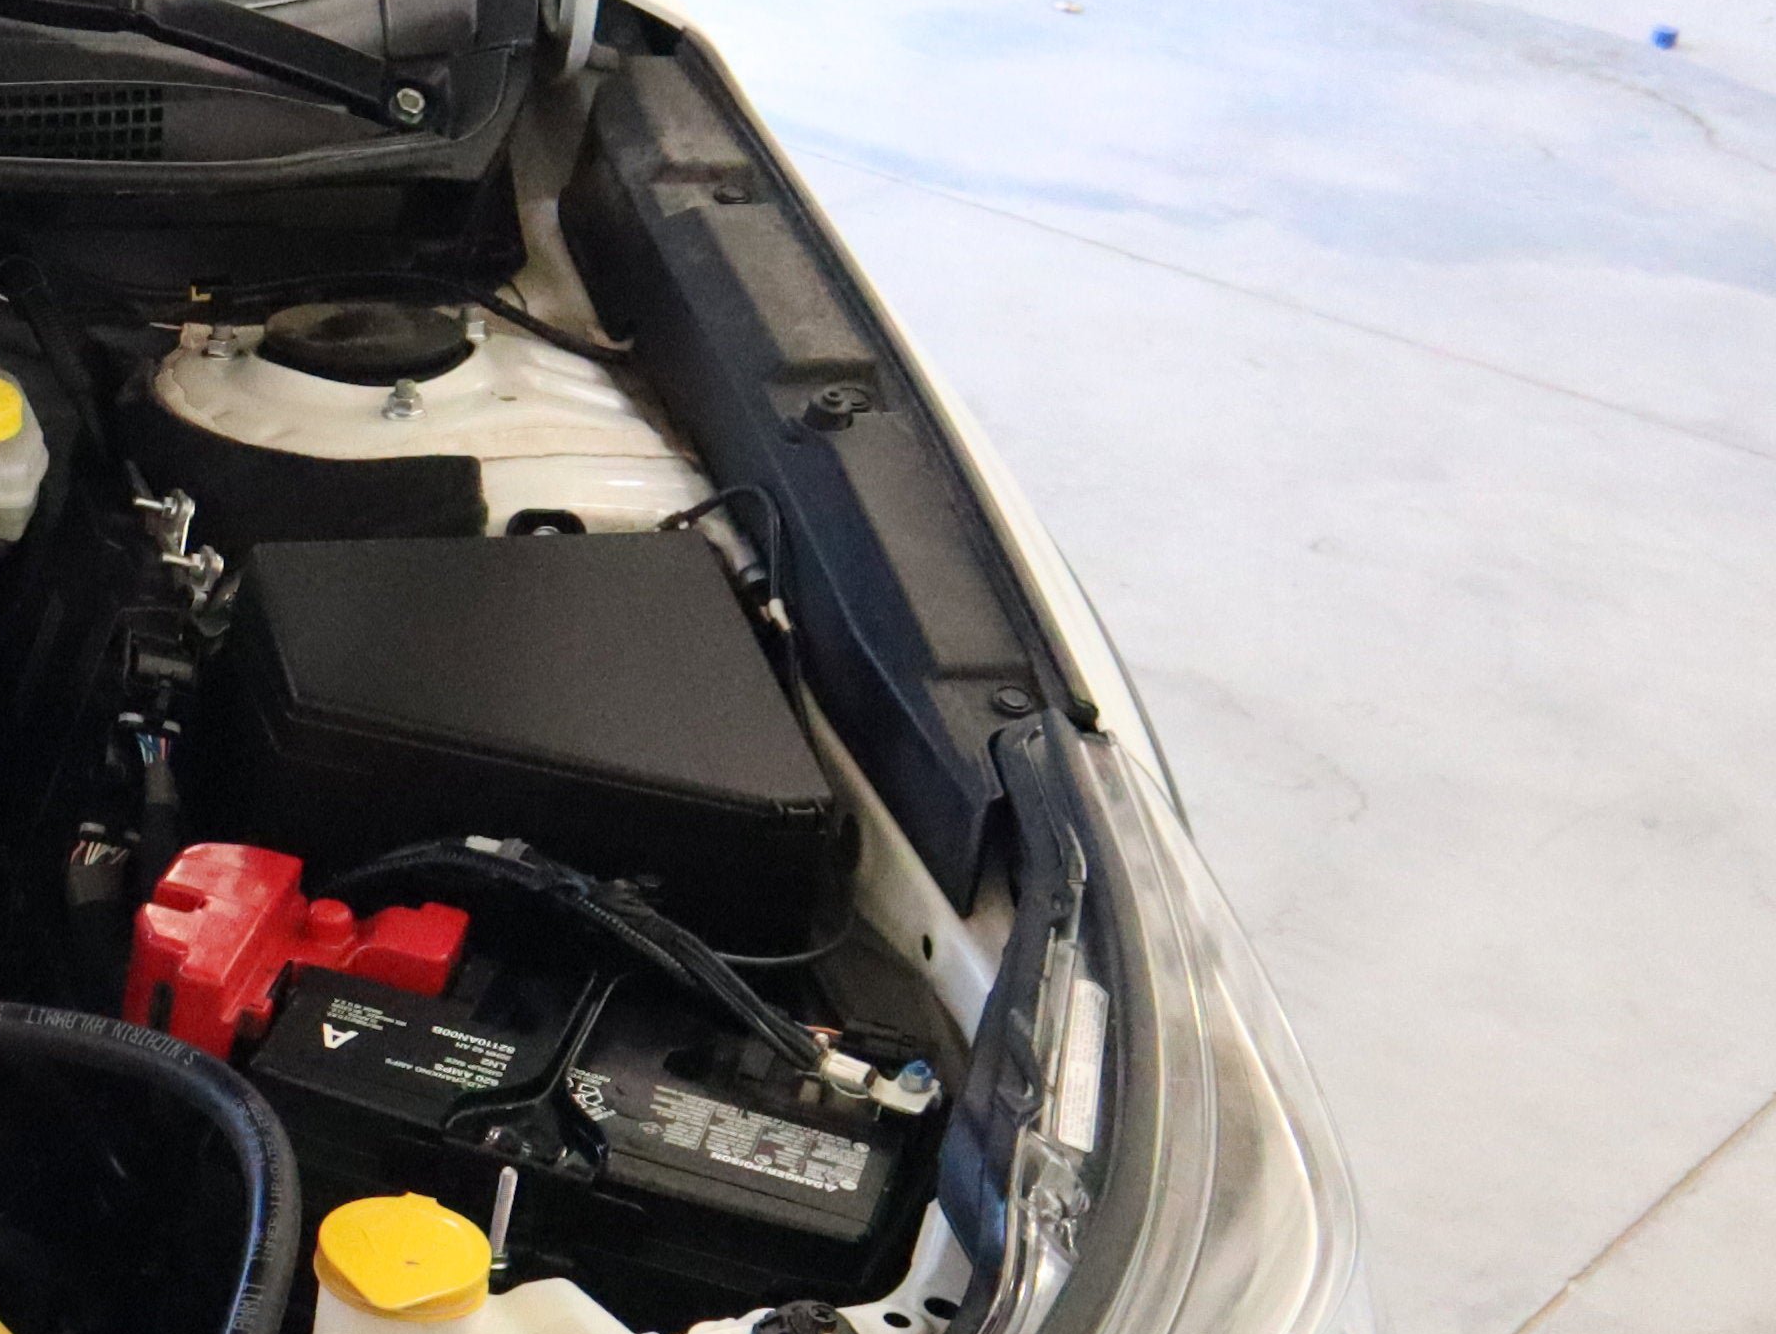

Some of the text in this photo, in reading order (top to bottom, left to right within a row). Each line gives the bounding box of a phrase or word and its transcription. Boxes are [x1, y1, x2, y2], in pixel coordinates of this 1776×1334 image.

[110, 1021, 185, 1059] NICHIRIN
[433, 1062, 475, 1080] AMPS
[479, 1057, 507, 1072] LN2
[710, 1151, 824, 1189] DANGER/POISON
